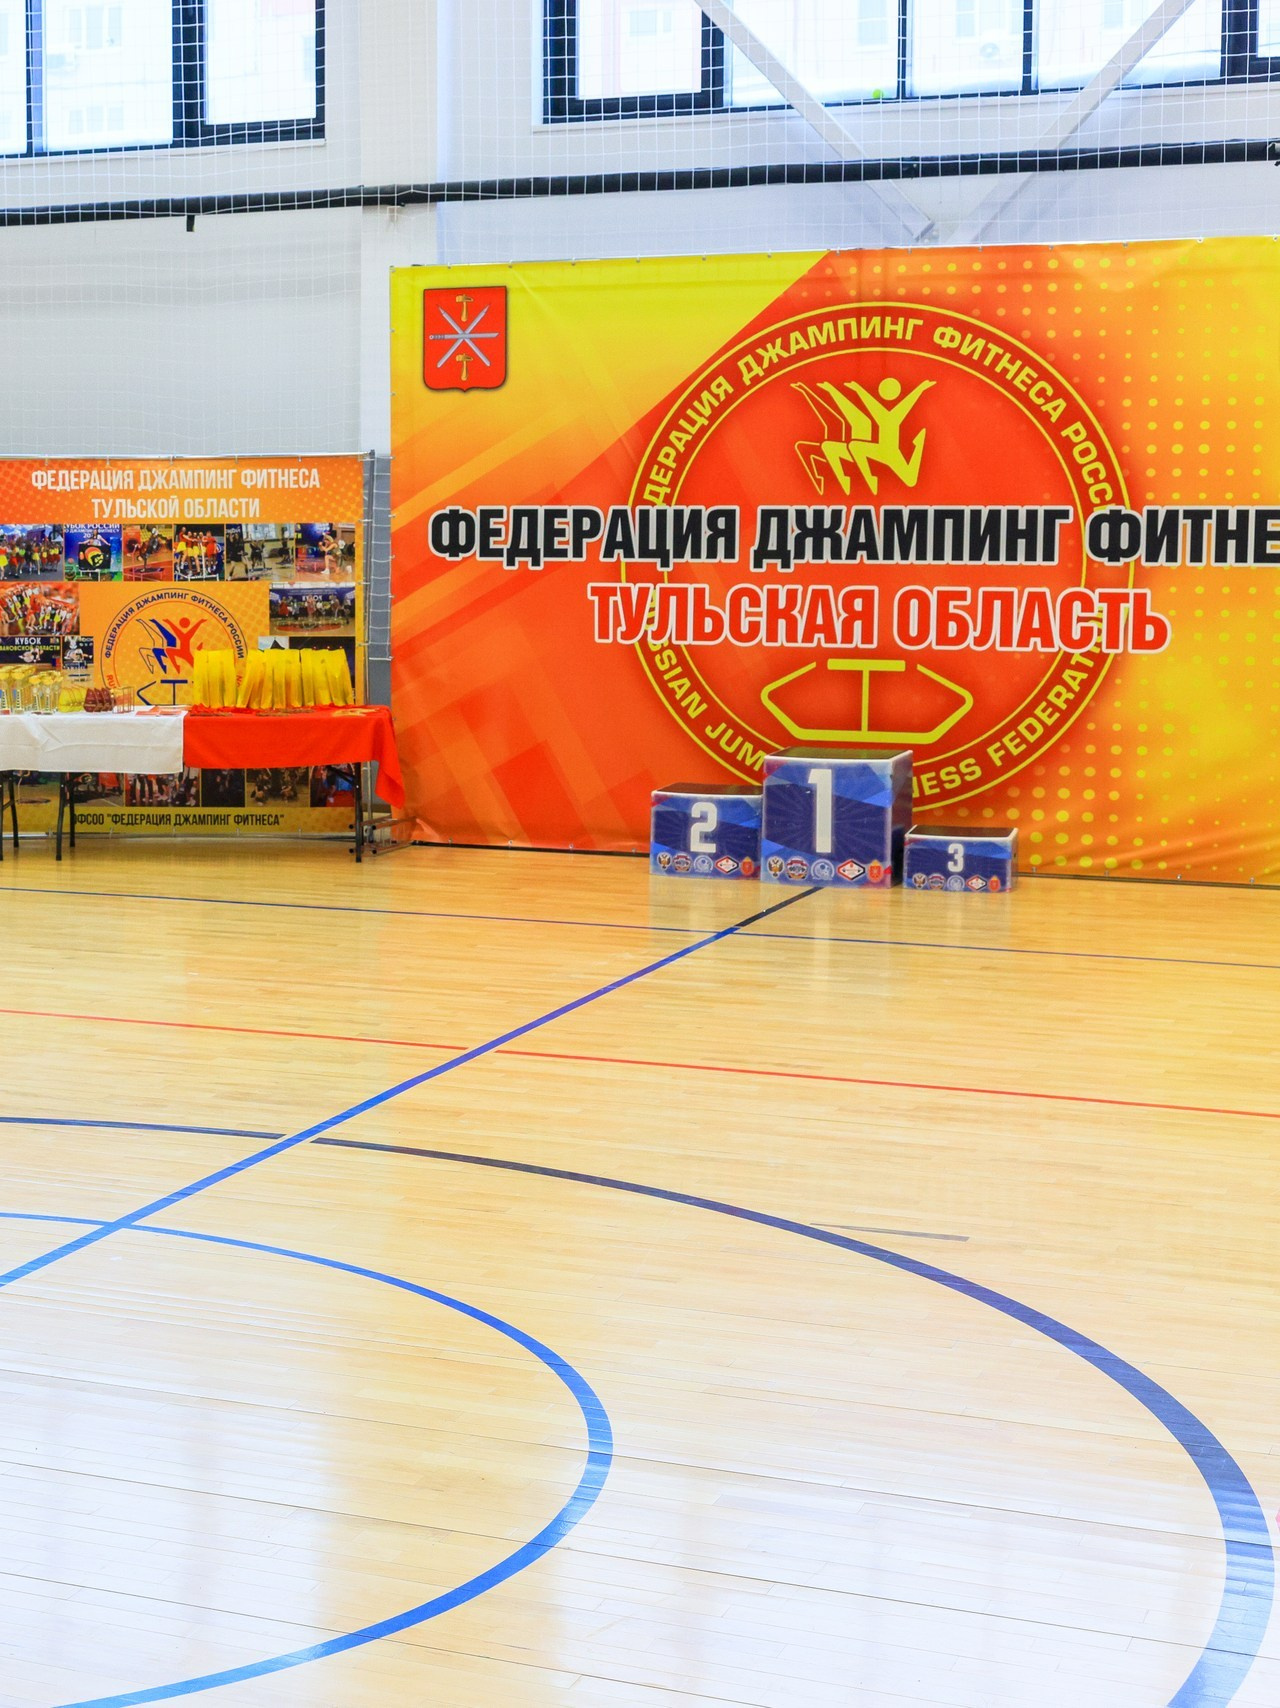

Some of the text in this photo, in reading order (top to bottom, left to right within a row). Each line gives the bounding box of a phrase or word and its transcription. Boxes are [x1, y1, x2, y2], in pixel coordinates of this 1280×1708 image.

[642, 316, 1116, 511] ДЕРАЦИЯ ДЖАМПИНГ ФИТНЕСА РОСС
[30, 467, 321, 491] ФЕДЕРАЦИЯ ДЖАМПИНГ ФИТНЕСА
[91, 495, 260, 519] ТУЛЬСКОЙ ОБЛАСТИ
[429, 505, 1280, 572] ФЕДЕРАЦИЯ ДЖАМПИНГ ФИТНЕ
[14, 637, 42, 645] КУБОК
[104, 591, 245, 659] ФЕДЕРАЦИЯ ДЖАМПИНГ ФИТНЕСА РОССИИ
[587, 582, 1172, 655] ТУЛЬСКАЯ ОБЛАСТЬ
[704, 722, 767, 772] JUM
[986, 607, 1103, 768] FEDERAT
[106, 813, 172, 827] "ФЕДЕРАЦИЯ
[173, 813, 231, 827] ДЖАМПИНГ
[233, 813, 285, 826] ФИТНЕСА"
[689, 801, 718, 853] 2
[807, 768, 833, 853] 1
[947, 842, 965, 873] 3
